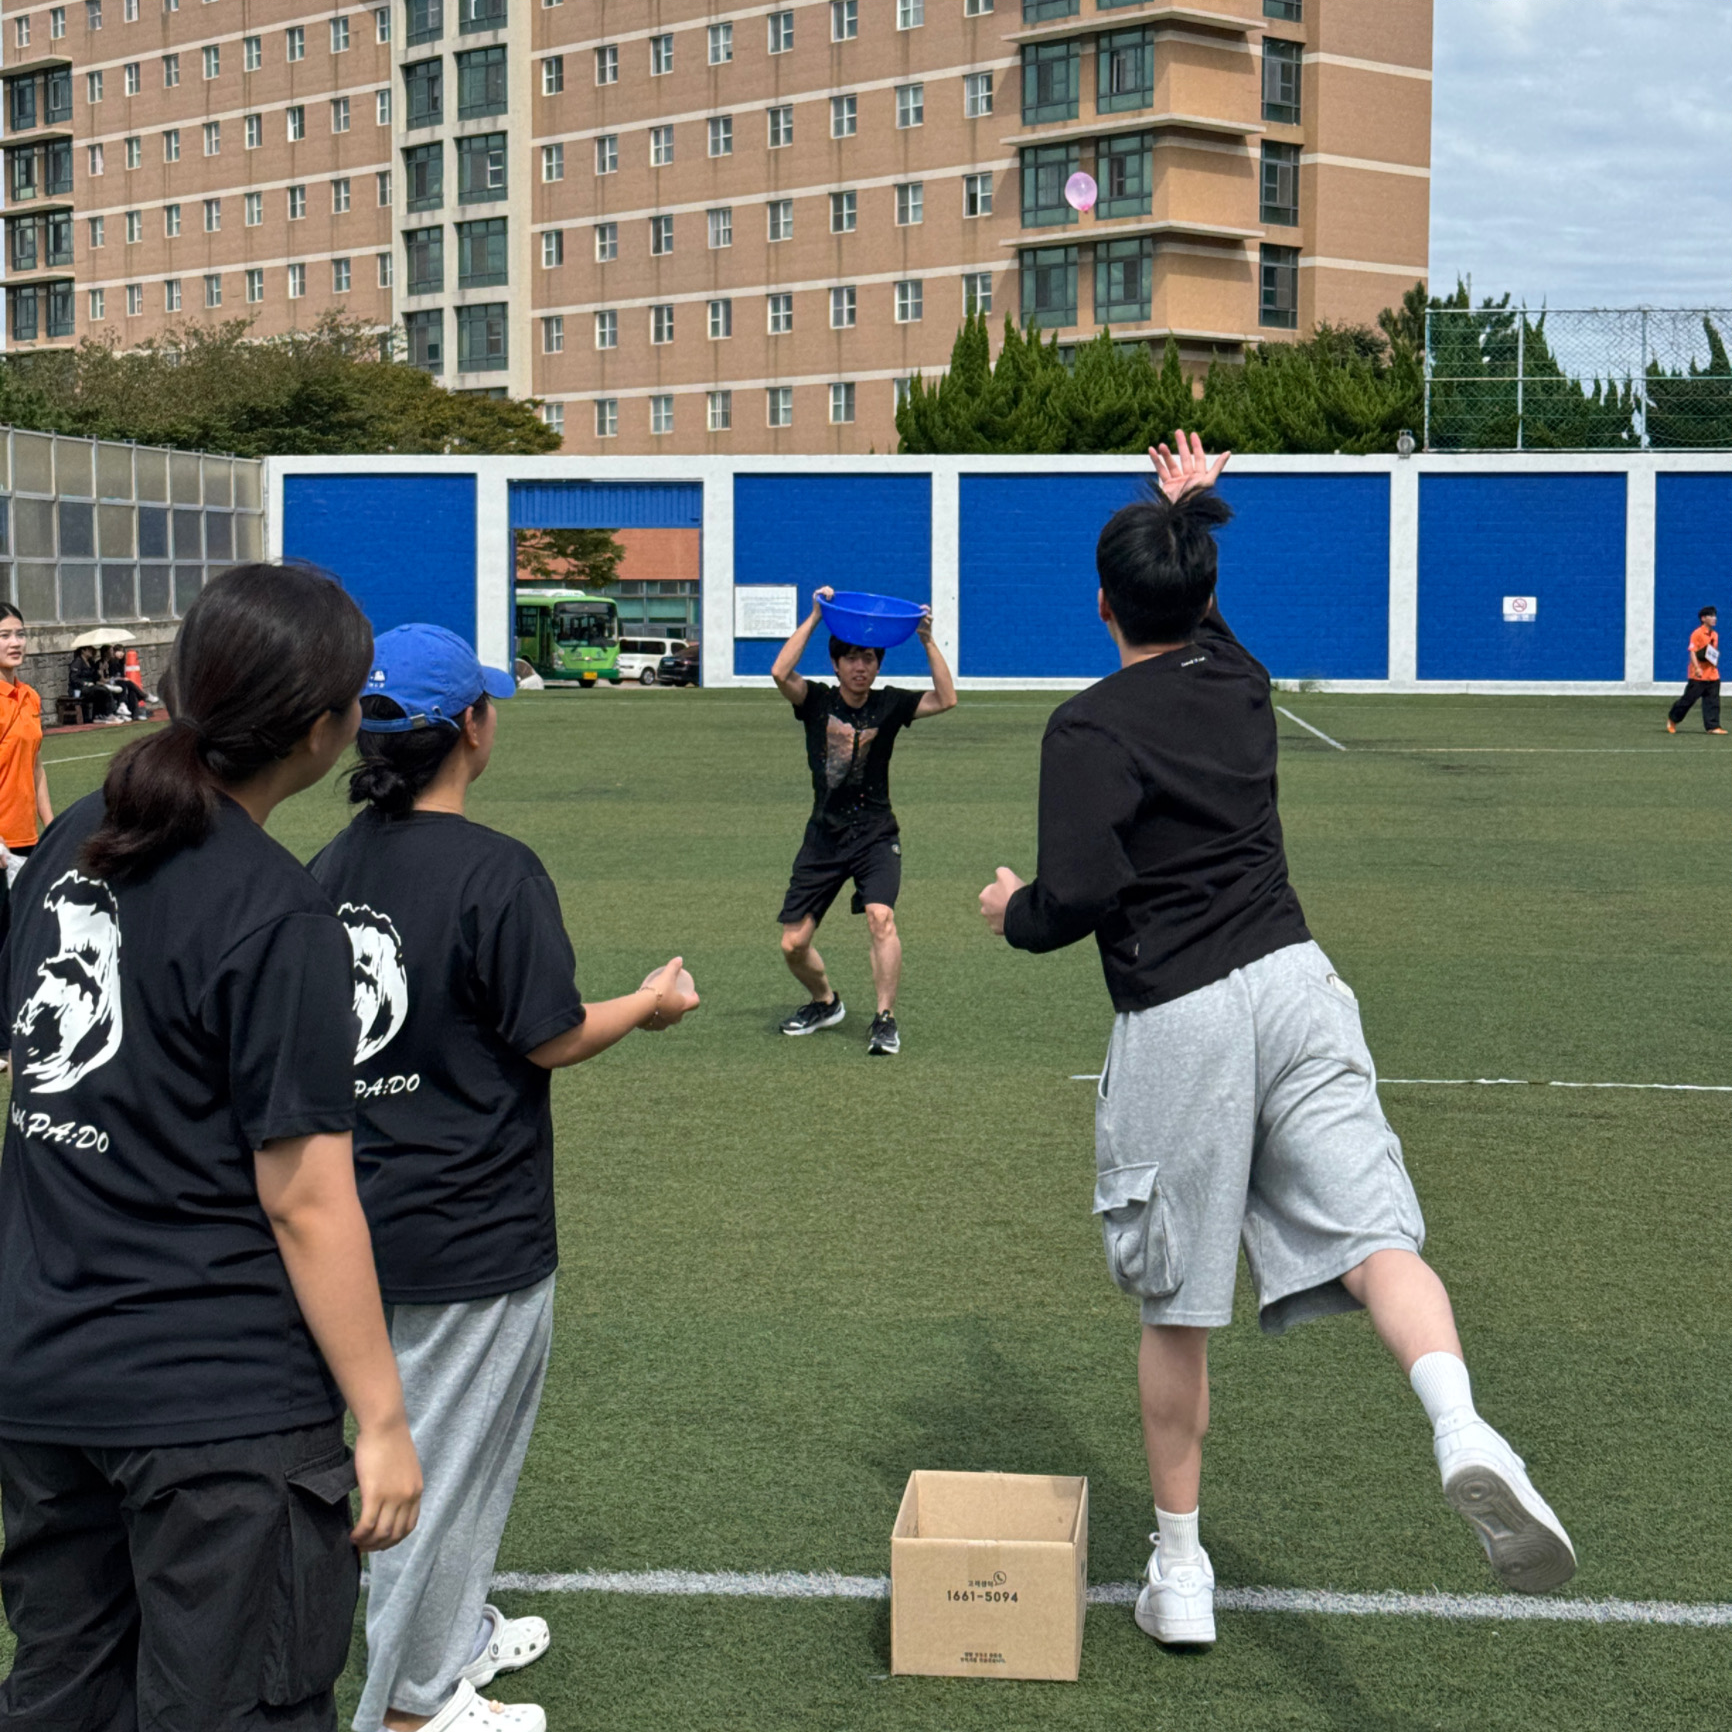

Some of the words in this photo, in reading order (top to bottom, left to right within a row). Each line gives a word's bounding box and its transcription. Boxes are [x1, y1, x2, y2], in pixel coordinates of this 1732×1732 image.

[354, 1073, 421, 1099] PA:DO
[25, 1112, 109, 1153] PA:DO
[946, 1589, 1019, 1603] 1661-5094
